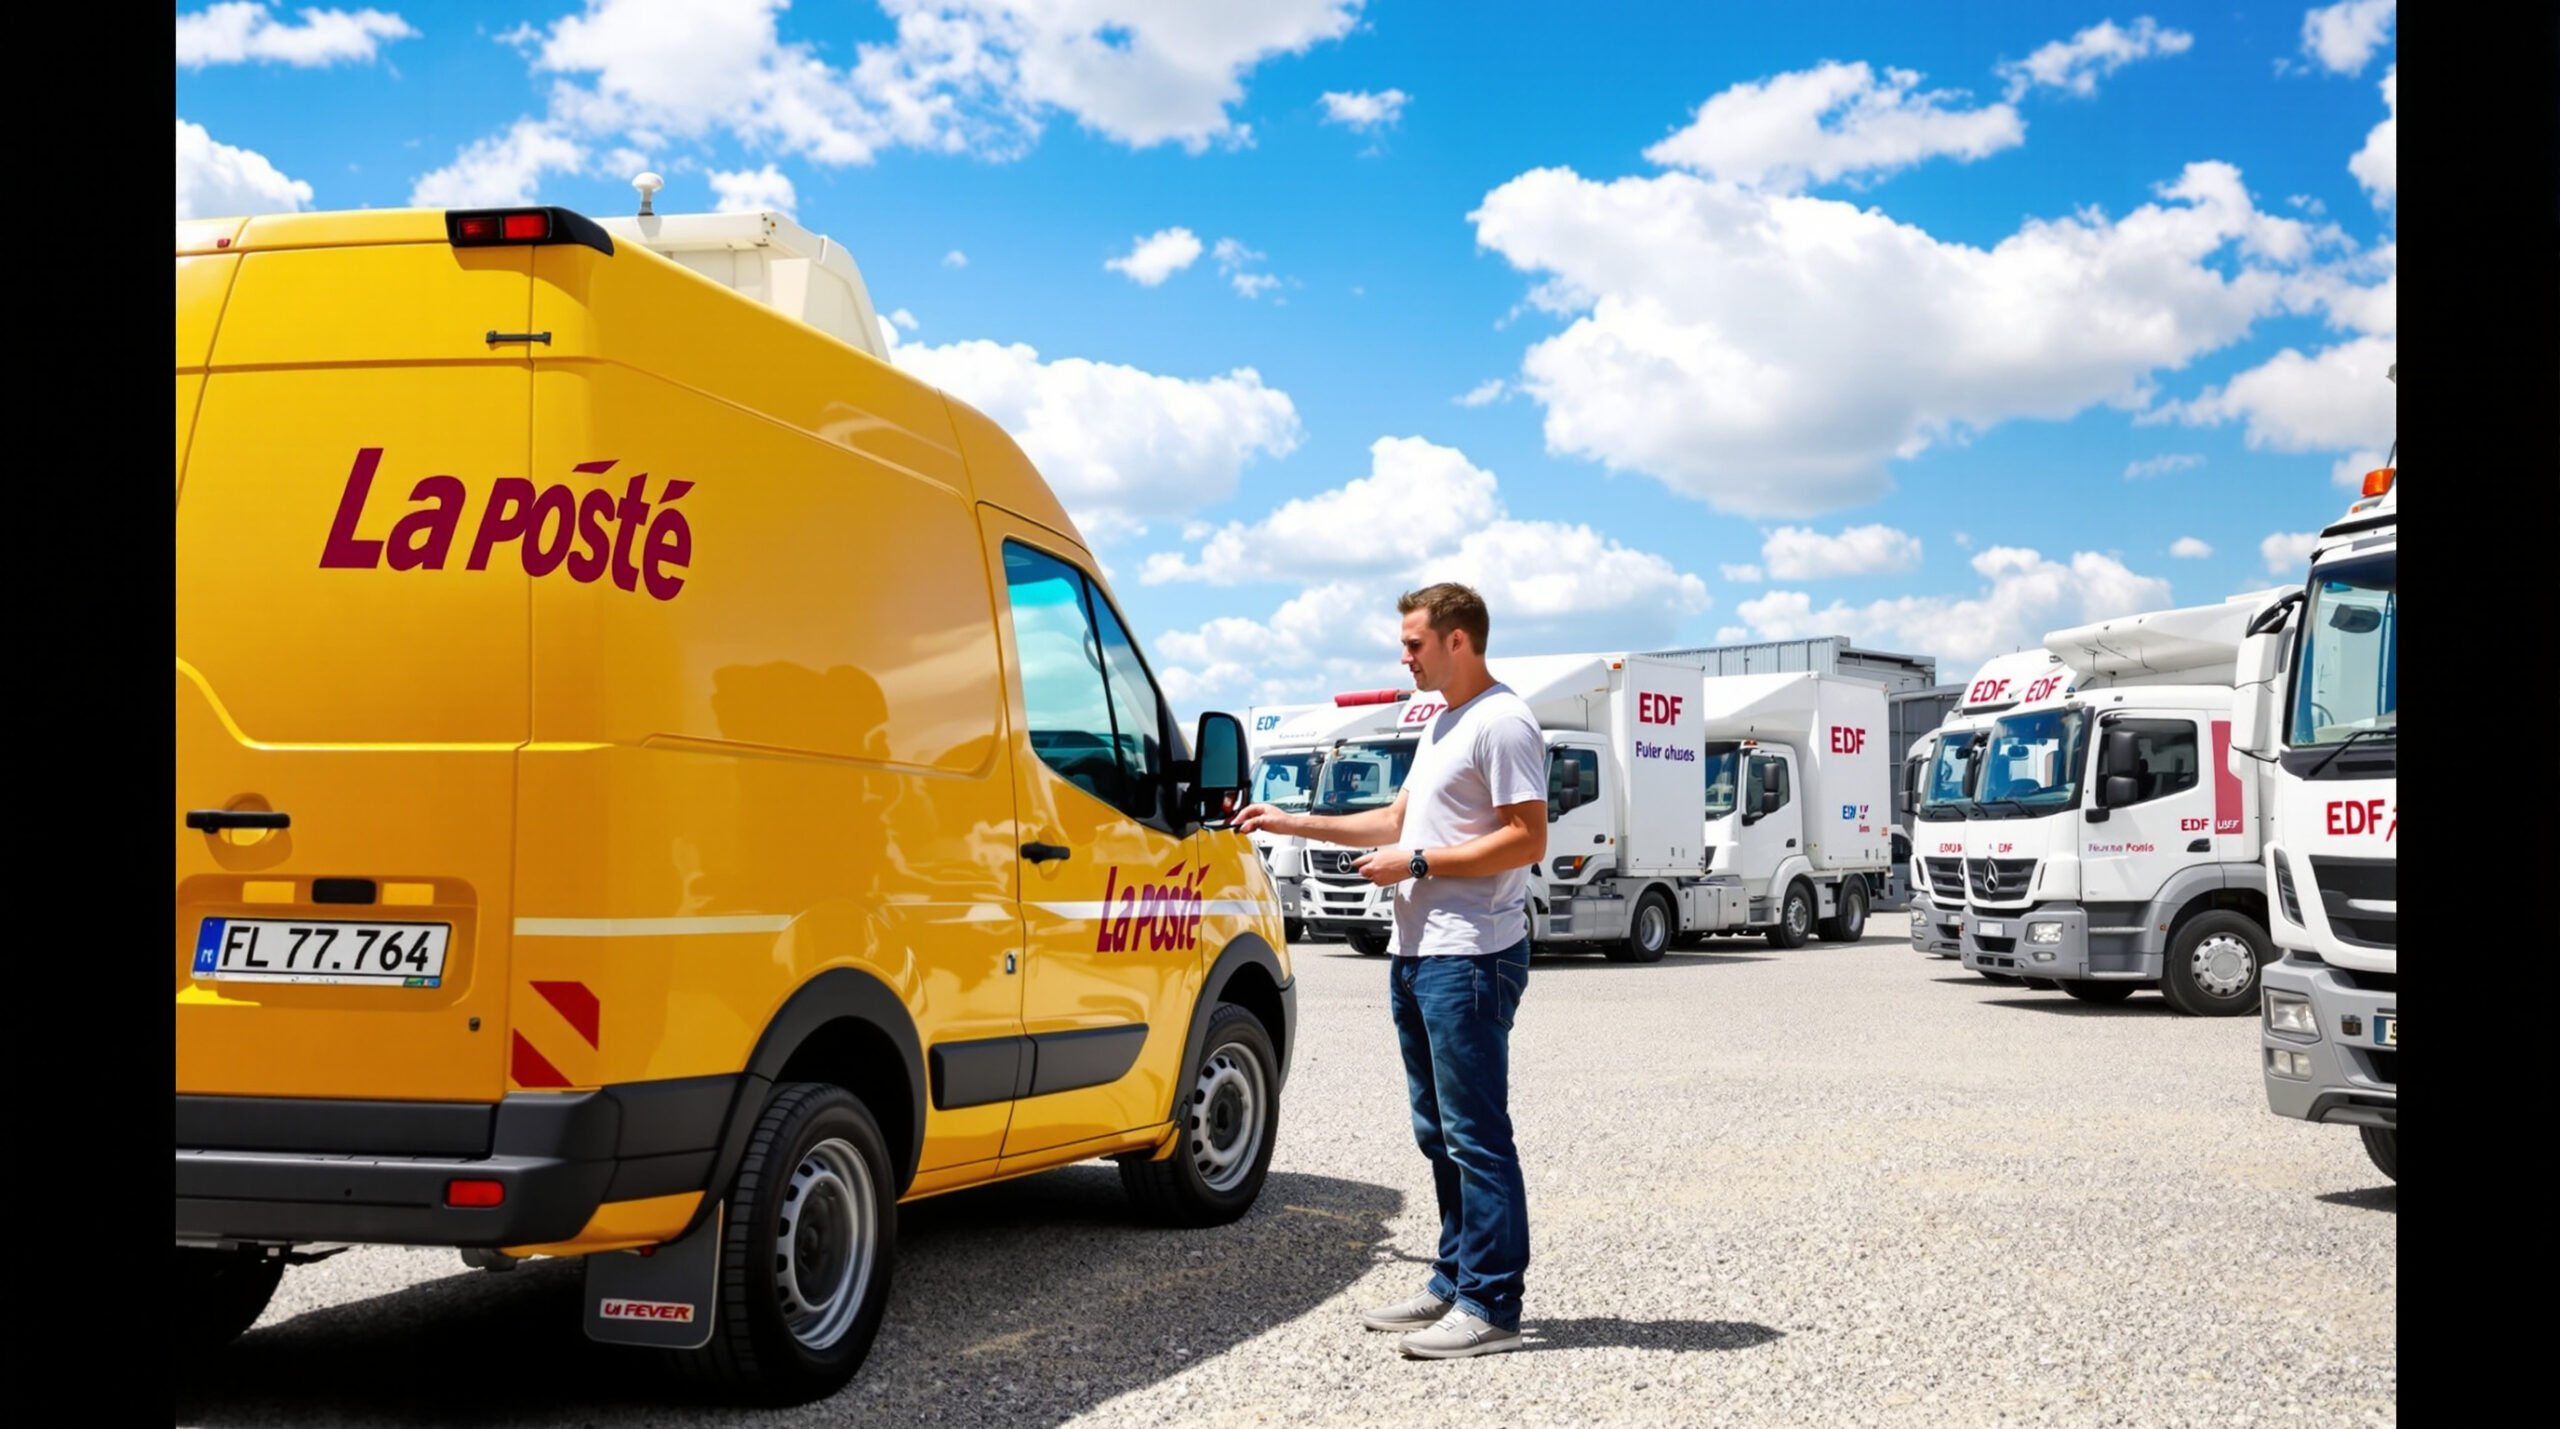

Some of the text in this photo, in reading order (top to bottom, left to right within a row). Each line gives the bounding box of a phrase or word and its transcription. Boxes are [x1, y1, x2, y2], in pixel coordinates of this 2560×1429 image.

[319, 447, 466, 571] La
[1970, 679, 2011, 703] EDF
[2025, 675, 2063, 703] EDF
[1639, 692, 1683, 726] EDF
[1831, 726, 1866, 755] EDF
[2181, 819, 2209, 831] EDF
[2327, 799, 2385, 835] EDF
[1096, 866, 1135, 952] La
[222, 926, 431, 972] FL 77.764
[624, 1304, 690, 1320] FEVER
